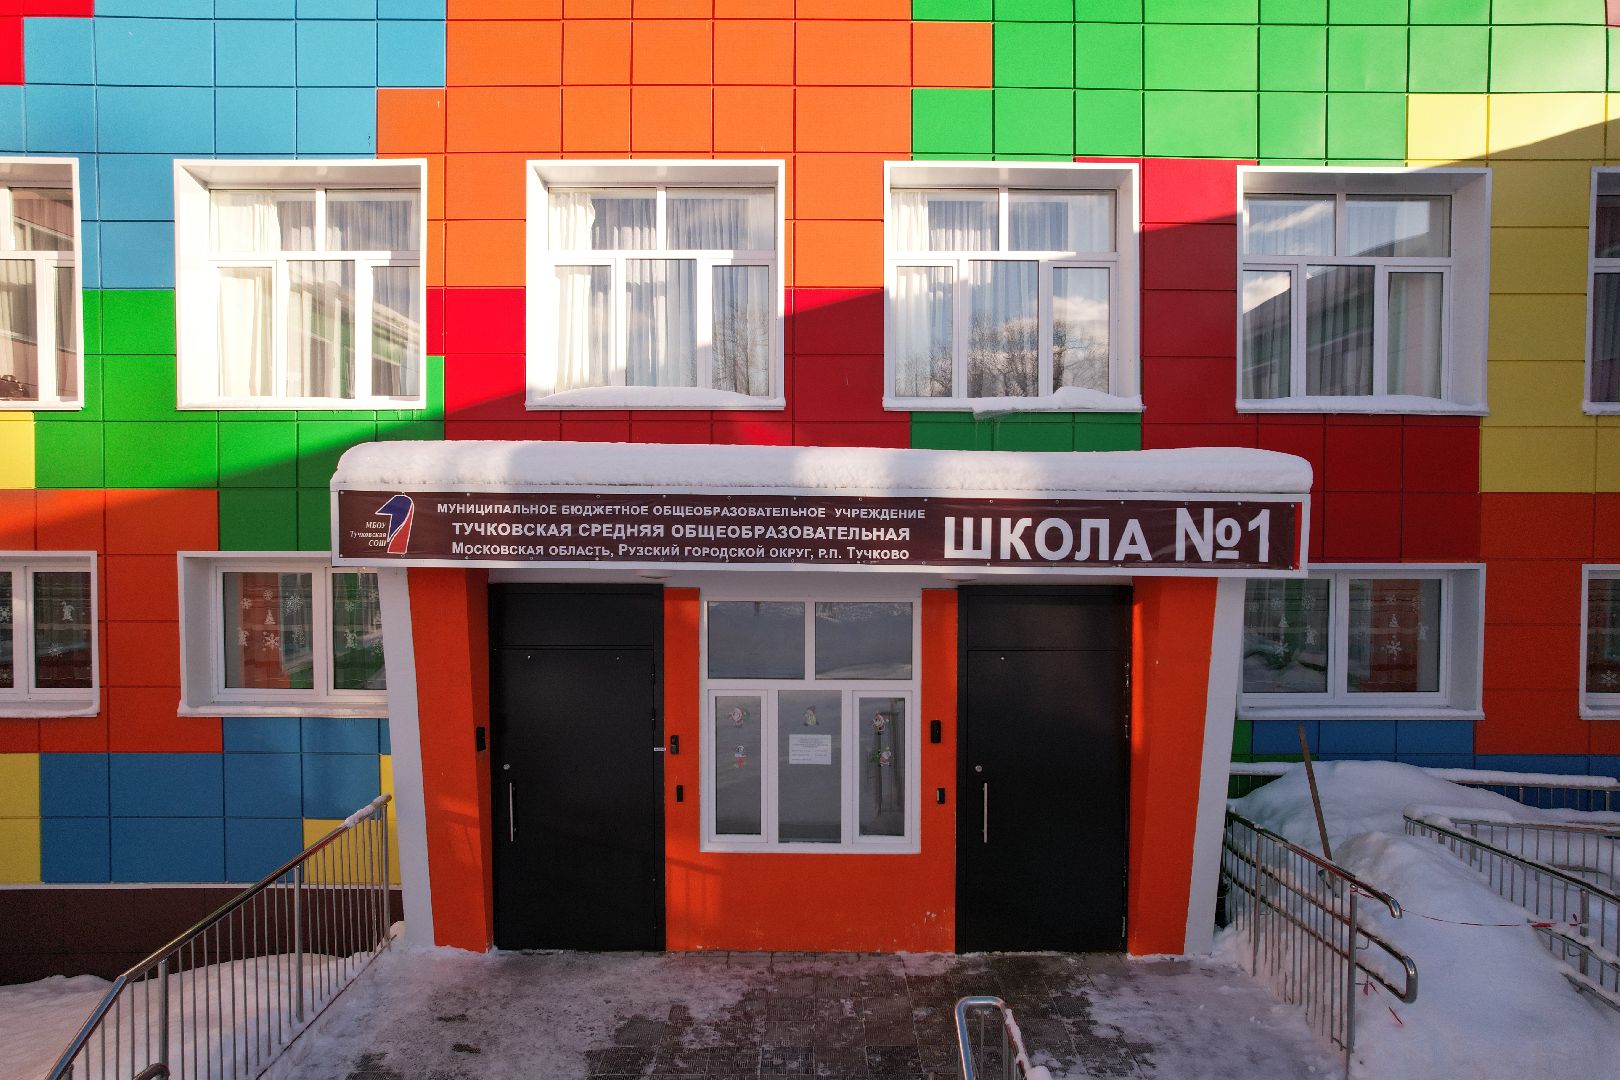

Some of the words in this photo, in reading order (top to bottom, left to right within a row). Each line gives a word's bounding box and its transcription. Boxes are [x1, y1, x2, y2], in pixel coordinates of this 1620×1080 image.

[437, 503, 557, 515] МУНИЦИПАЛЬНОЕ
[562, 504, 648, 516] БЮДЖЕТНОЕ
[653, 505, 826, 517] ОБЩЕОБРАЗОВАТЕЛЬНОЕ
[834, 508, 926, 519] УЧРЕЖДЕНИЕ
[365, 521, 387, 529] МБОУ
[452, 522, 572, 537] ТУЧКОВСКАЯ
[578, 524, 665, 539] СРЕДНЯЯ
[671, 525, 911, 541] ОБЩЕОБРАЗОВАТЕЛЬНАЯ
[943, 517, 1153, 561] ШКОЛА
[1175, 507, 1270, 563] №1
